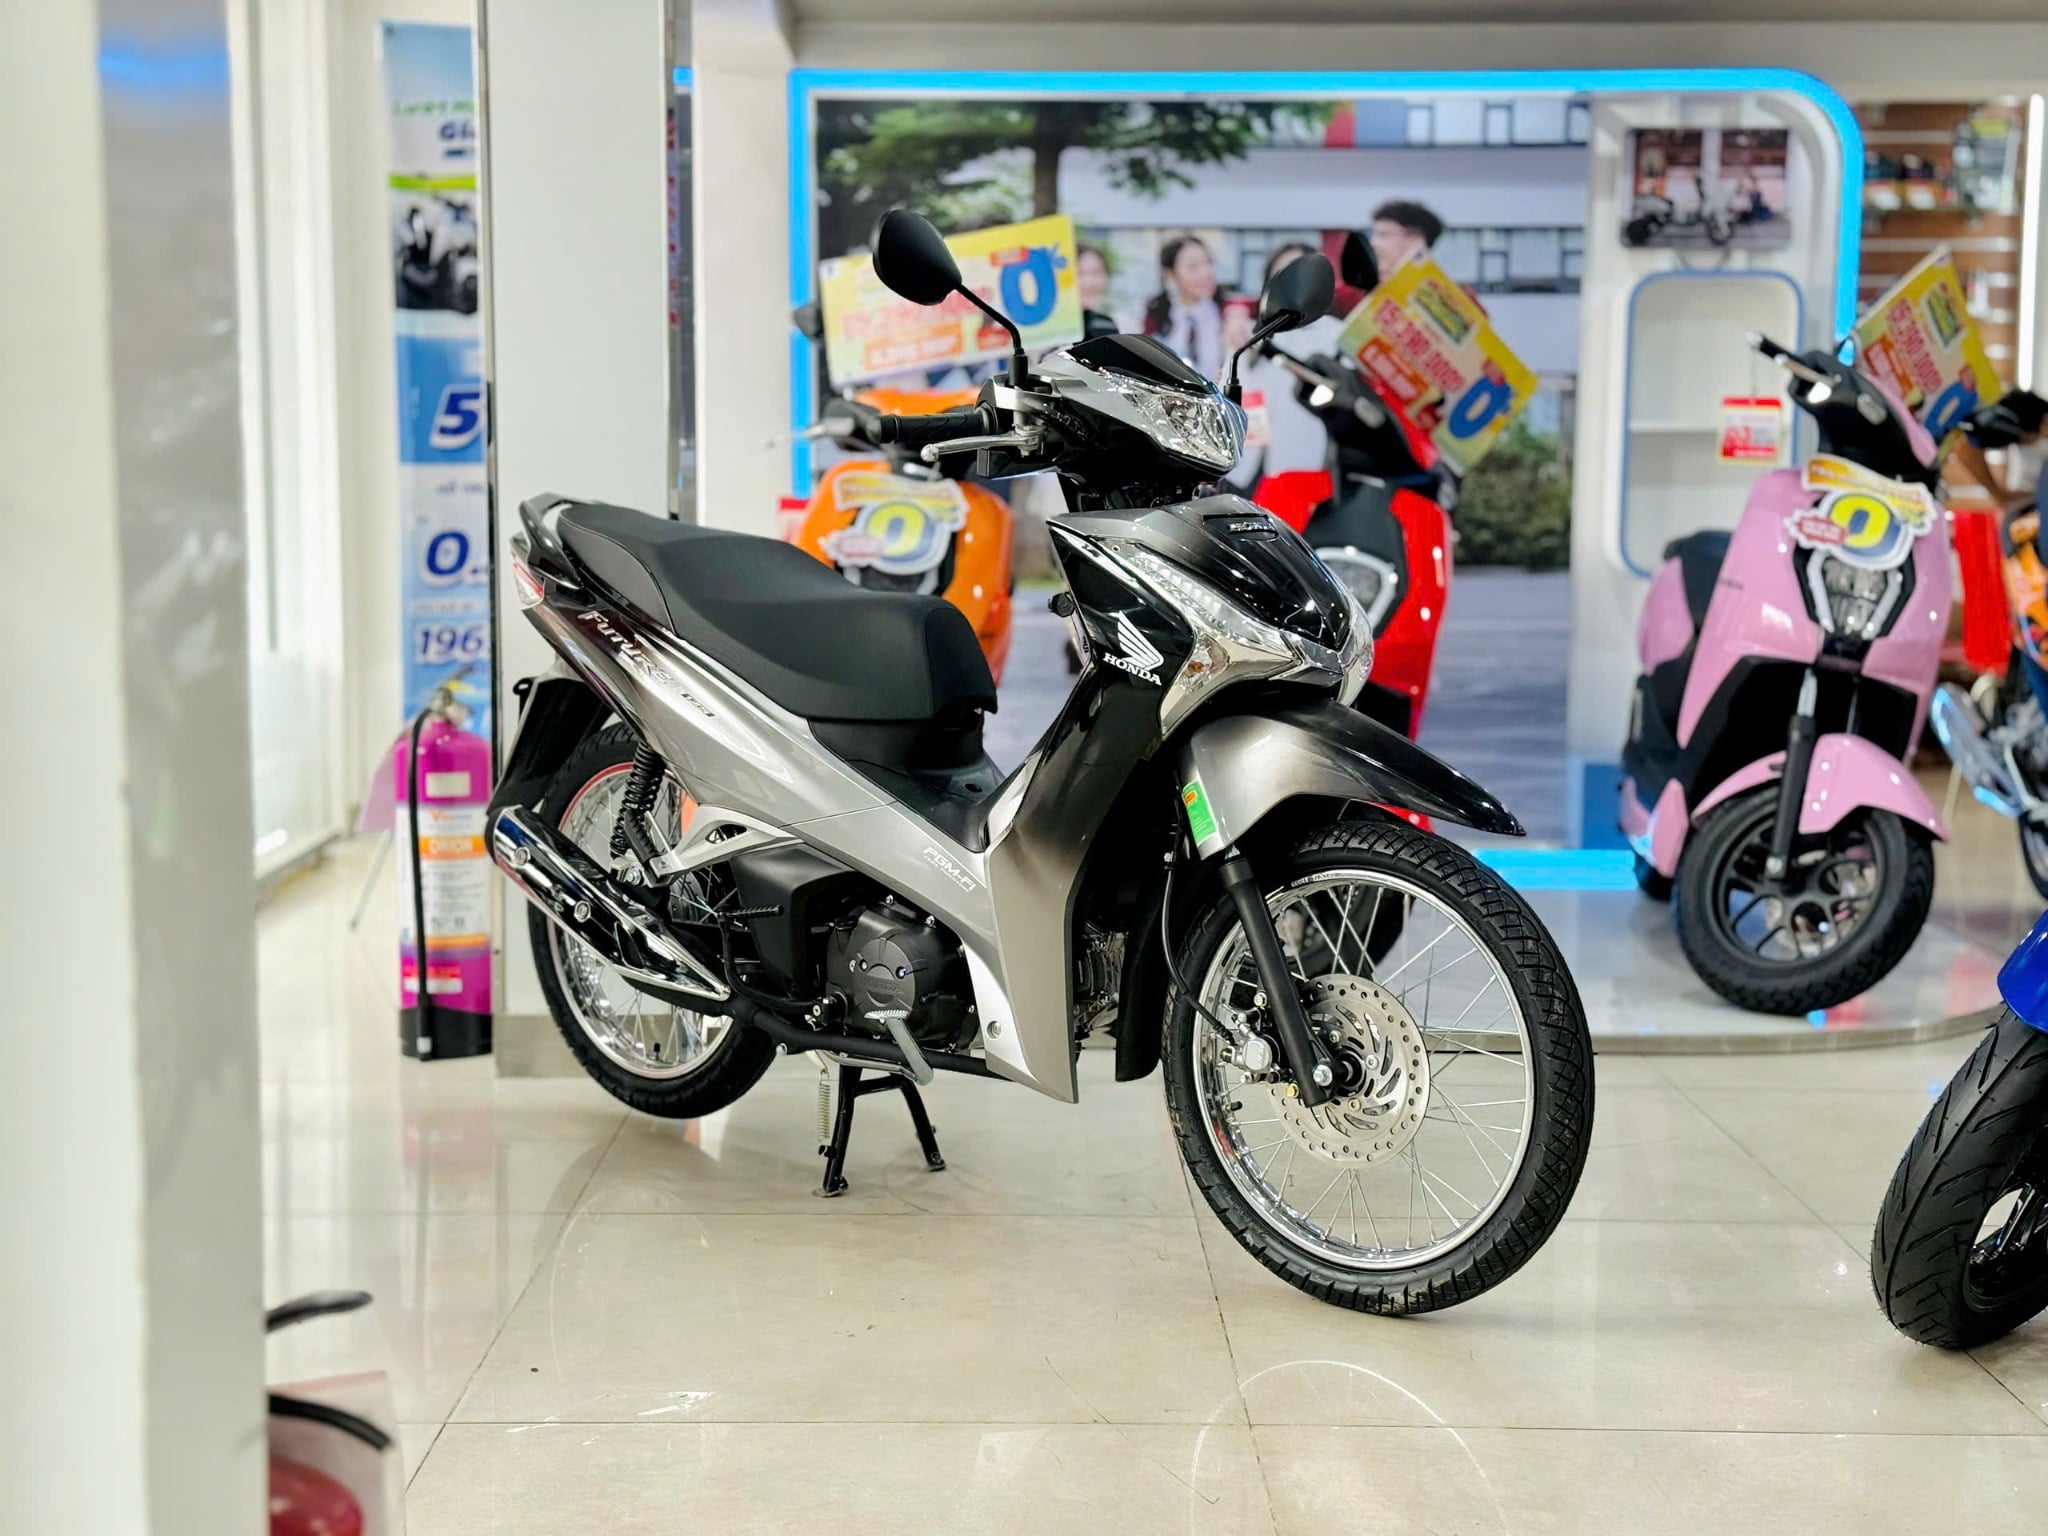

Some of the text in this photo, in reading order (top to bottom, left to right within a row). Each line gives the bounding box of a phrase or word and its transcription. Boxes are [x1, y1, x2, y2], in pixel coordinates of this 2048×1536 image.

[438, 390, 481, 436] 5
[1102, 652, 1163, 686] HONDA
[923, 846, 977, 892] PGM-FI
